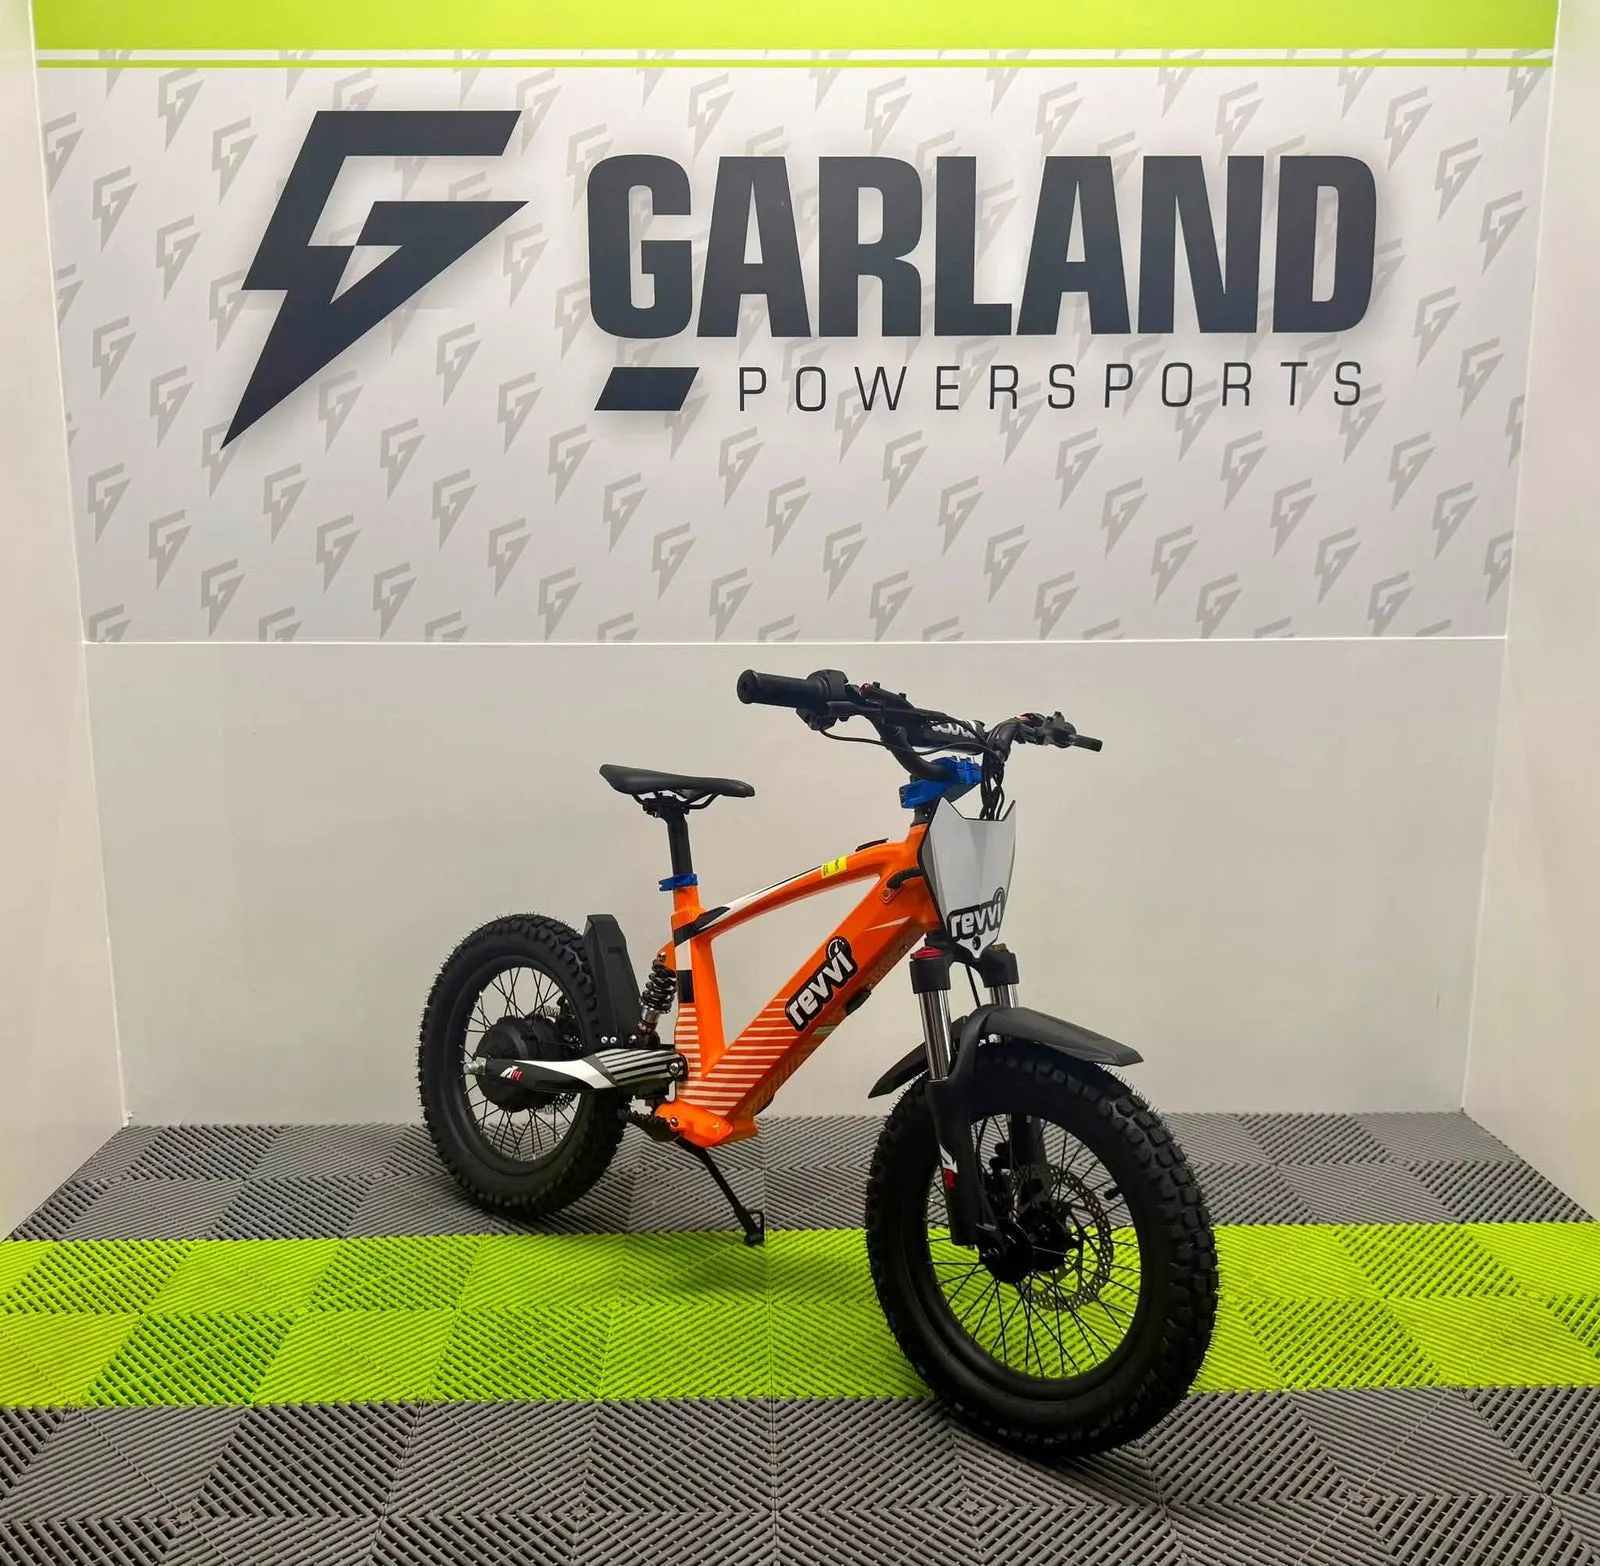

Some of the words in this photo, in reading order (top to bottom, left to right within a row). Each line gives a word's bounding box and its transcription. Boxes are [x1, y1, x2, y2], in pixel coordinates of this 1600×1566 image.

[587, 155, 1376, 339] GARLAND
[738, 361, 1362, 412] POWERSPORTS
[949, 891, 1002, 938] revvi
[788, 940, 854, 1026] revvi
